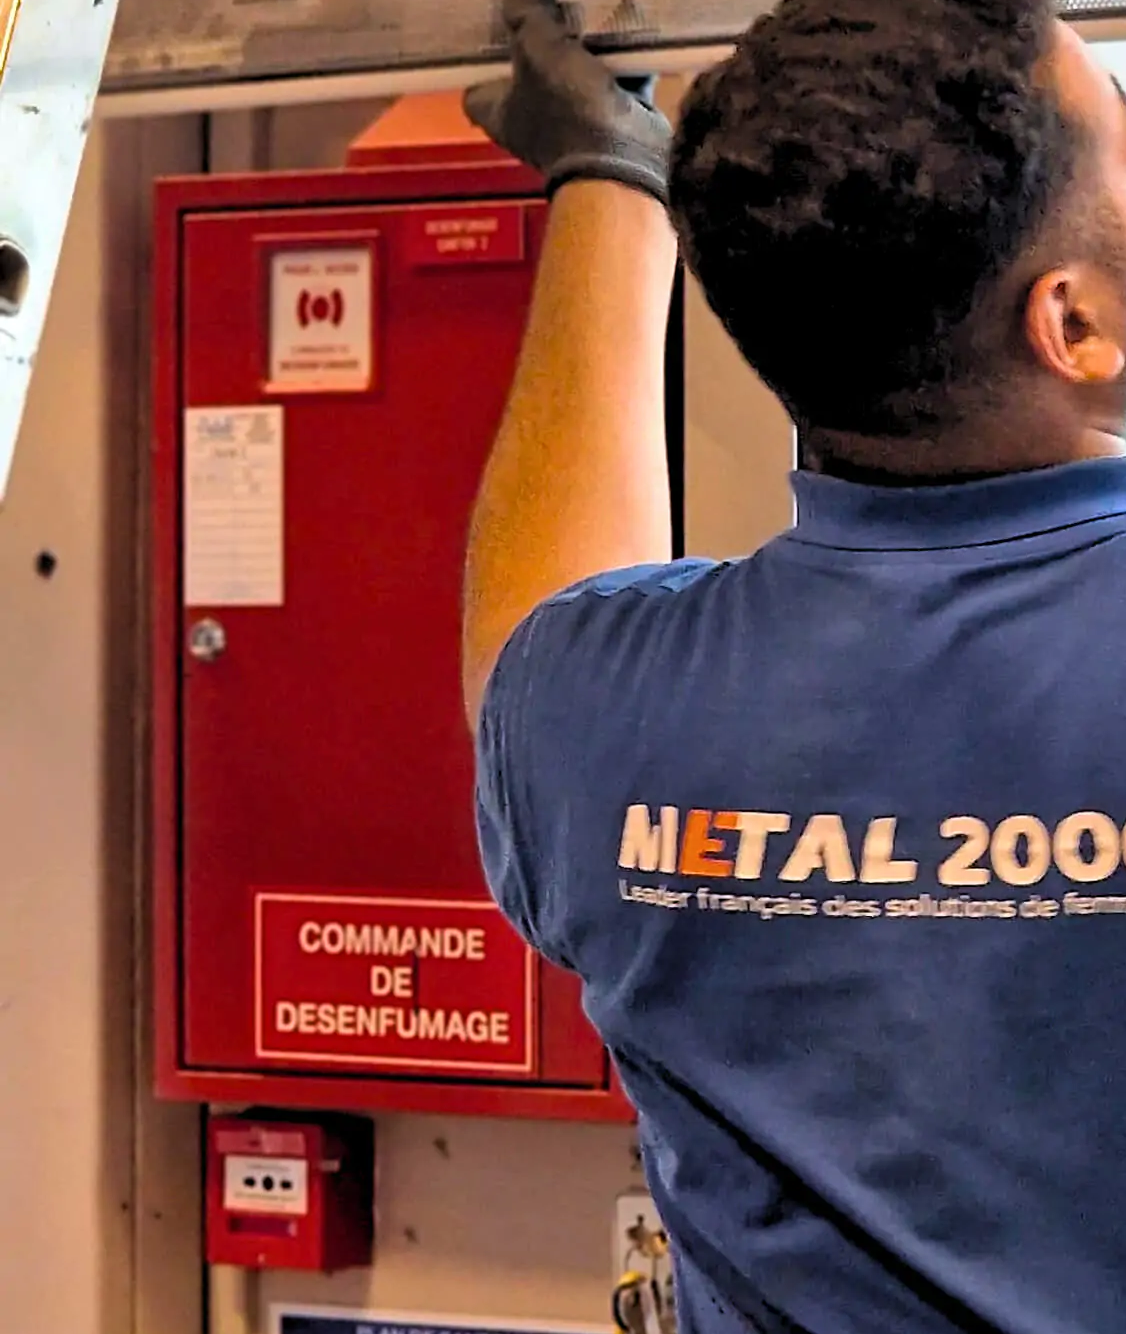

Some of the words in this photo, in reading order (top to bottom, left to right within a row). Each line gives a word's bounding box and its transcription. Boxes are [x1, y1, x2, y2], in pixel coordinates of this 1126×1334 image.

[618, 804, 918, 883] METAL
[696, 886, 817, 920] français
[822, 894, 881, 917] des
[1018, 894, 1060, 917] de
[300, 922, 485, 959] COMMANDE
[371, 967, 412, 997] DE
[276, 1002, 509, 1044] DESENFUMAGE
